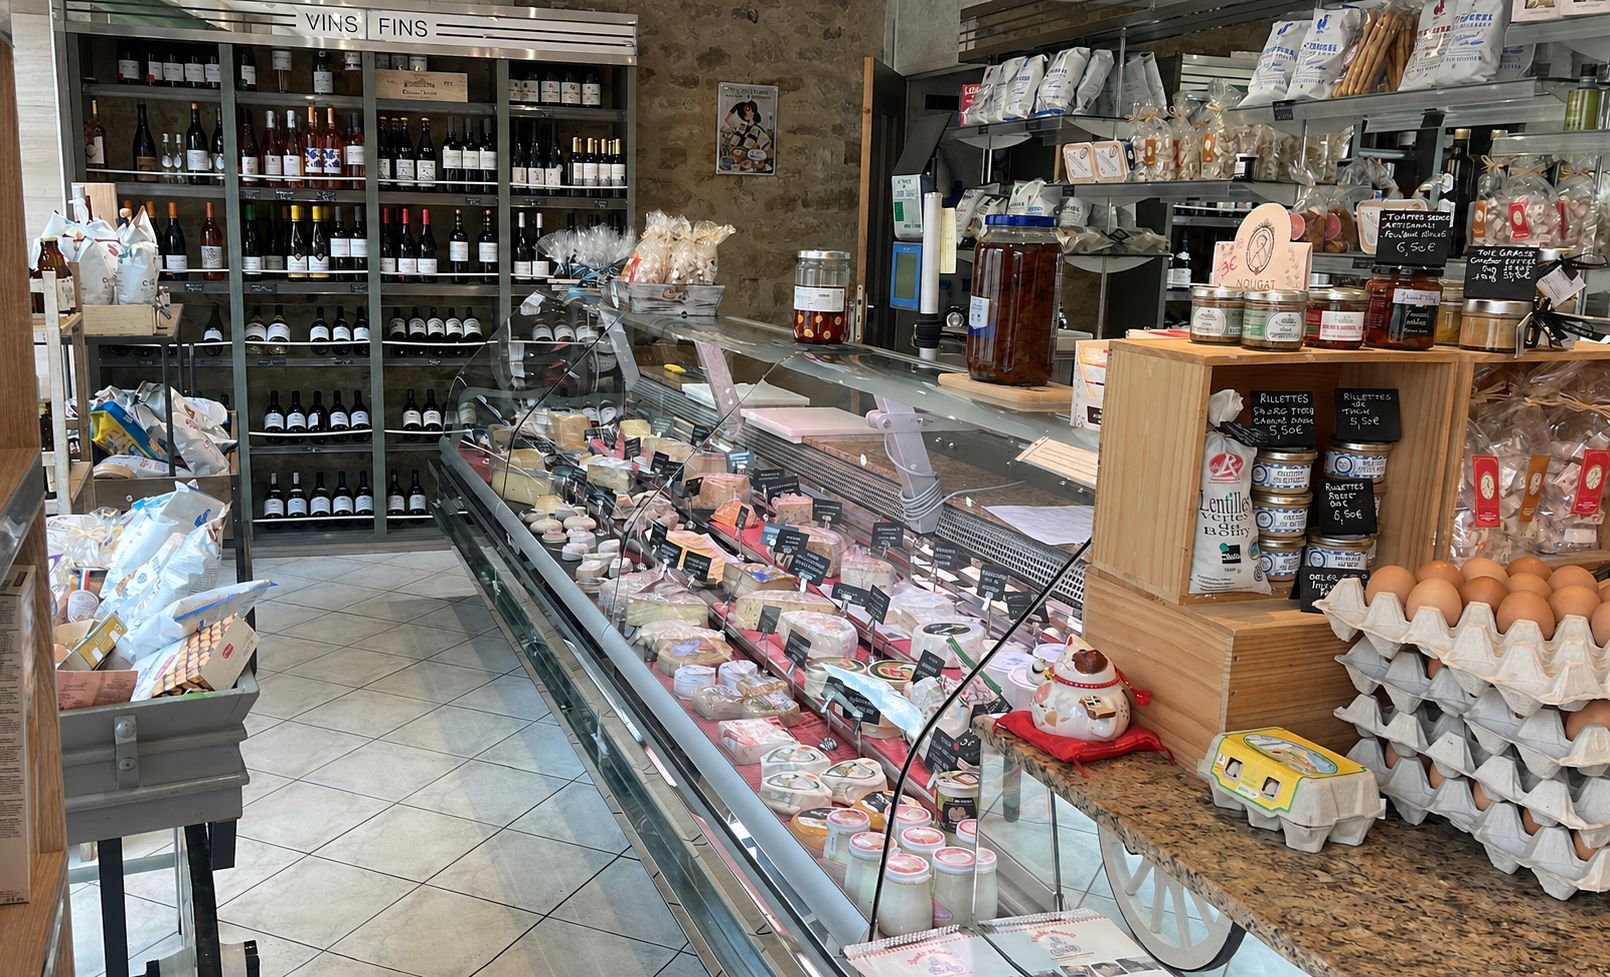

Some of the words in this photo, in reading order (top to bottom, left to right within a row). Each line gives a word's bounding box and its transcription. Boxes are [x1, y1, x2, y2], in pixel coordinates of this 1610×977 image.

[305, 12, 358, 33] VINS
[379, 17, 428, 37] FINS
[1237, 279, 1275, 290] NOUGAT
[1260, 393, 1309, 404] RILLETTES
[1269, 425, 1304, 440] 5,50€
